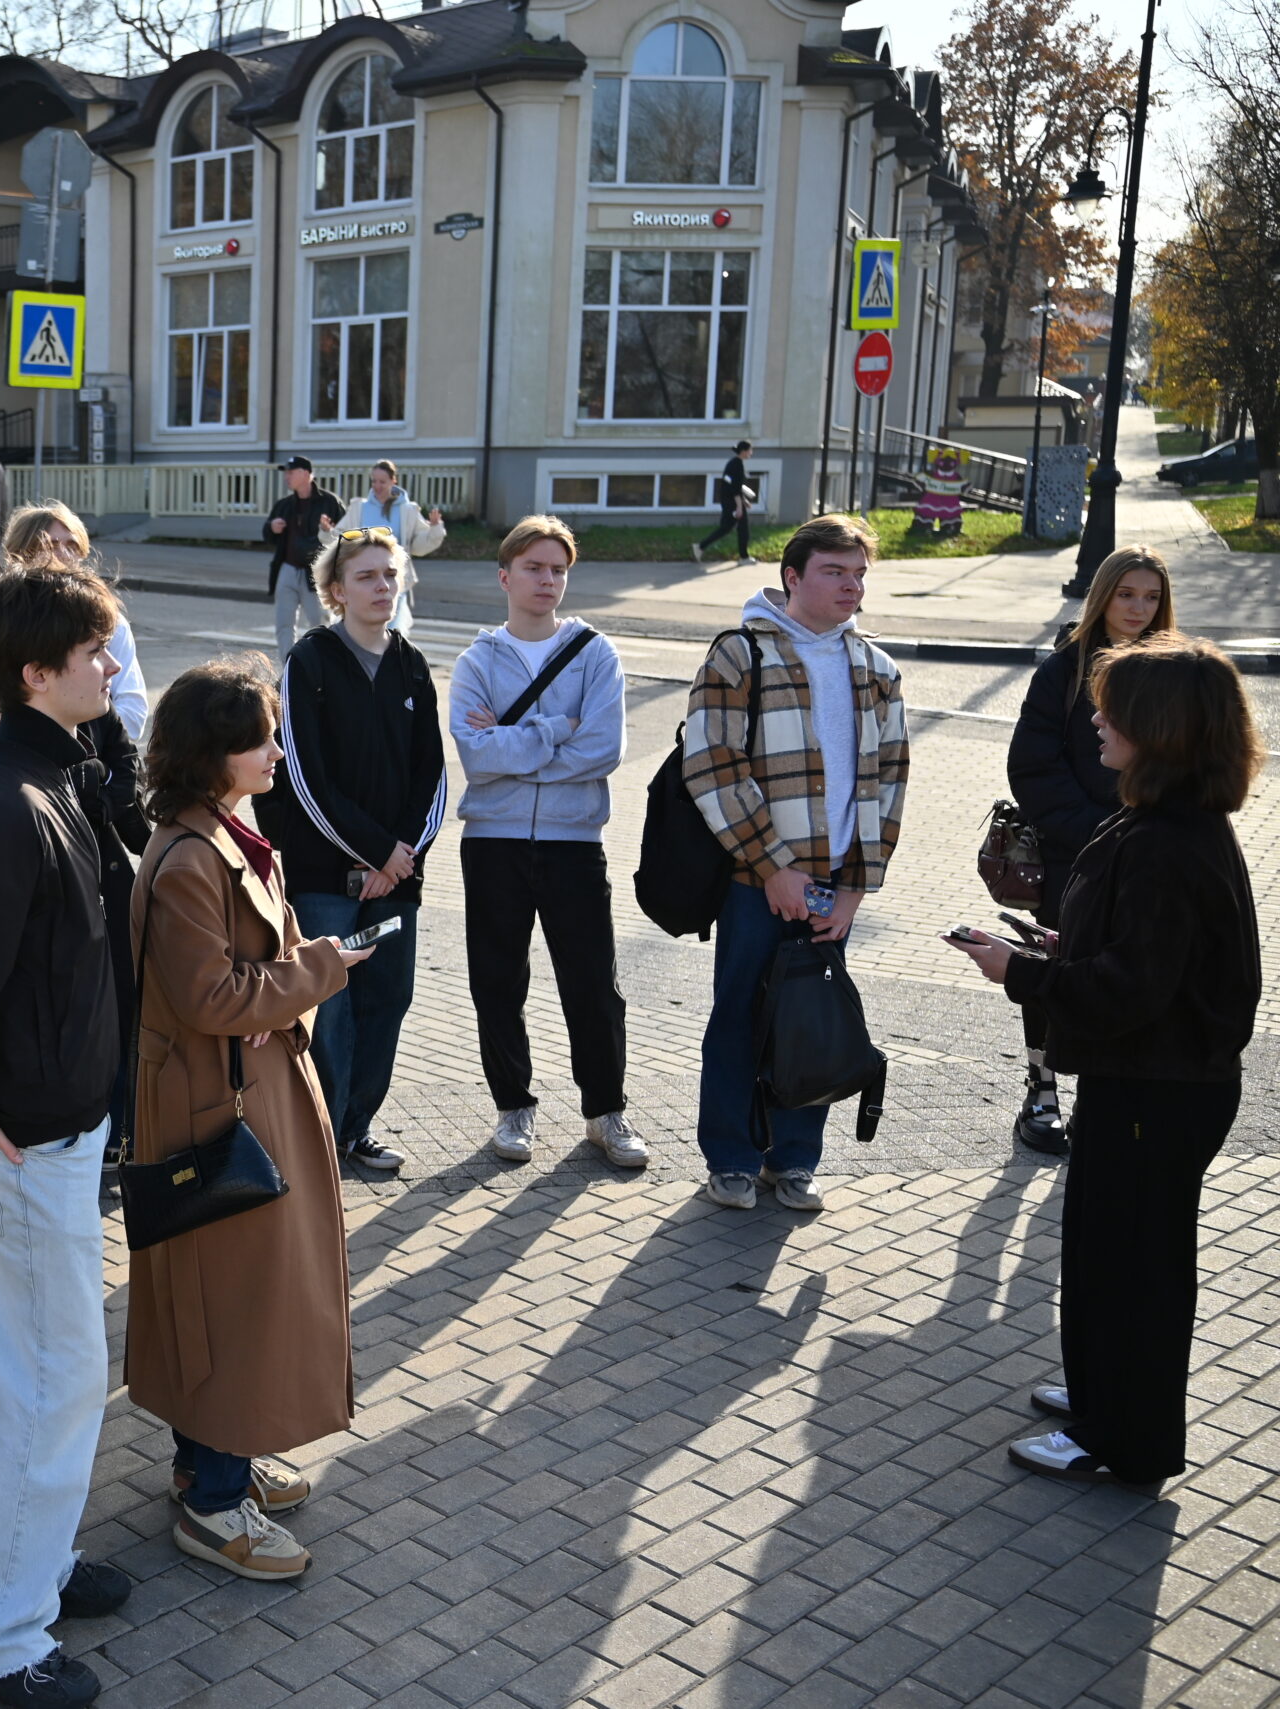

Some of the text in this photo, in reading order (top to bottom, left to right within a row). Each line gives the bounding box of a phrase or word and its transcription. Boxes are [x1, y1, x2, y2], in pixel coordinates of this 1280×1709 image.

[632, 210, 710, 228] Якитория
[300, 220, 408, 245] БАРЫНИ БИСТРО
